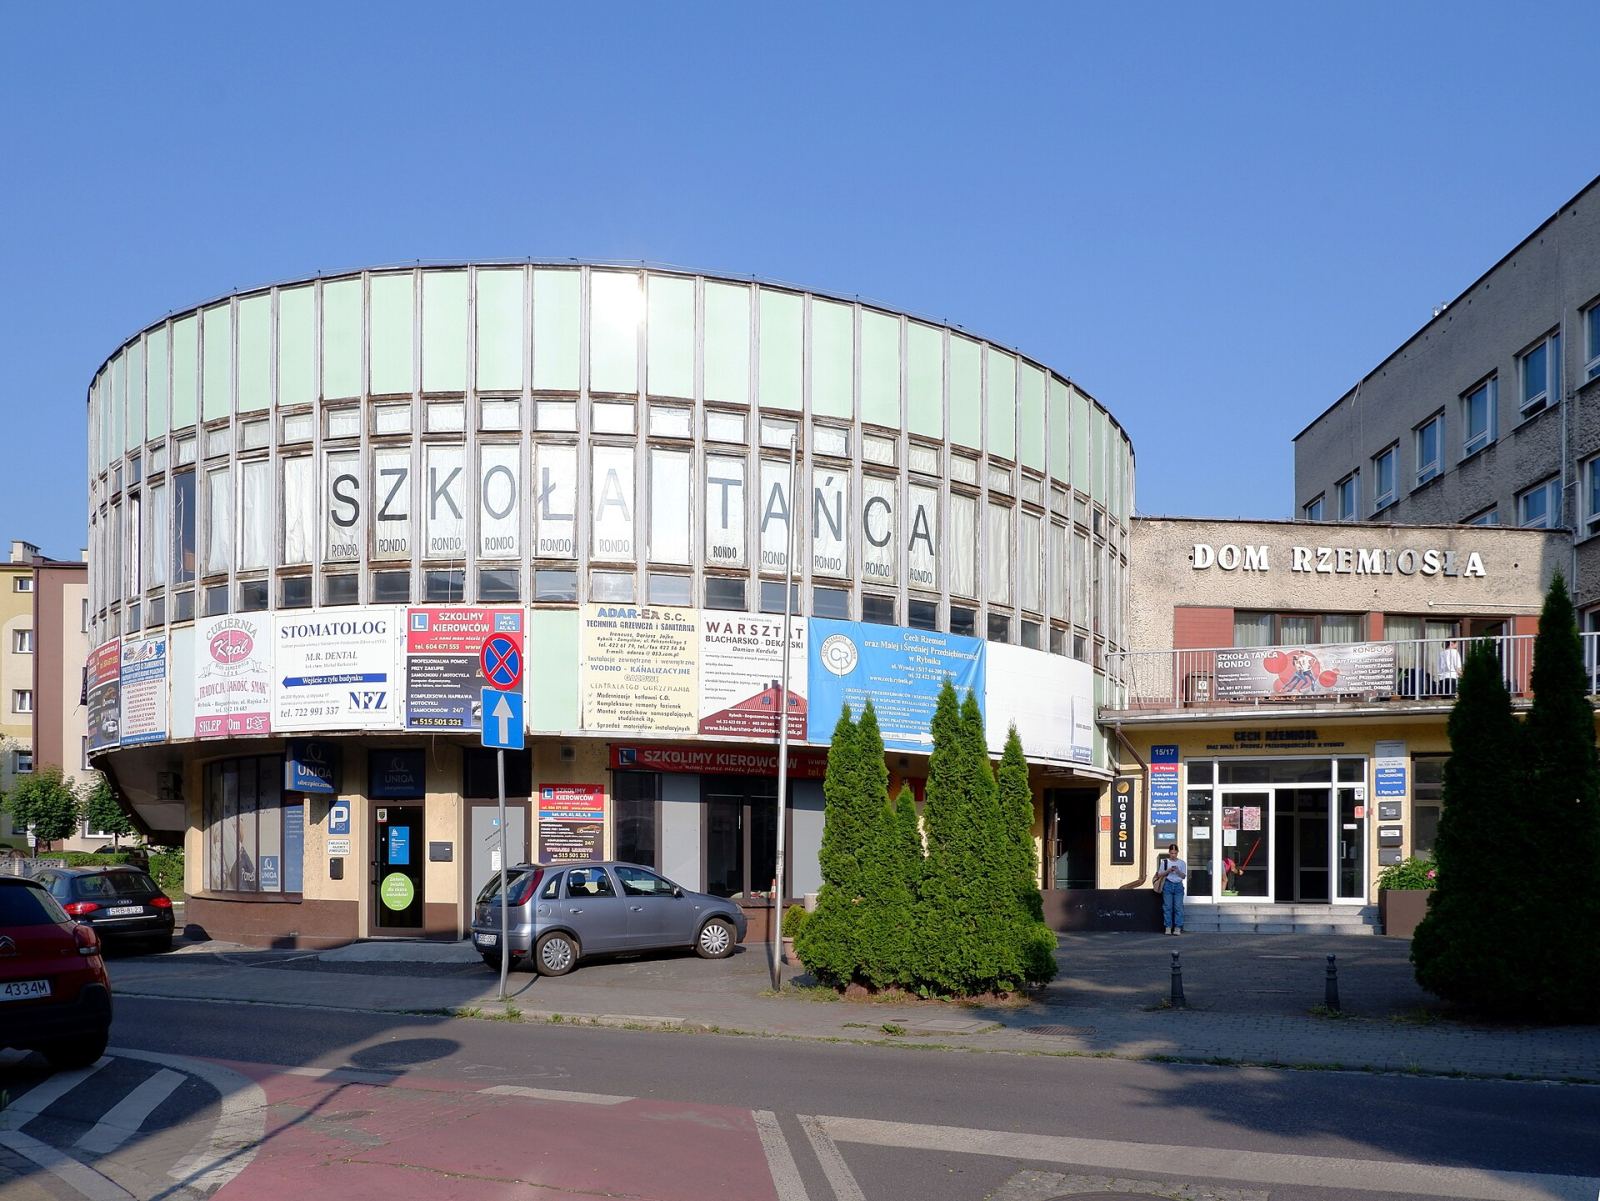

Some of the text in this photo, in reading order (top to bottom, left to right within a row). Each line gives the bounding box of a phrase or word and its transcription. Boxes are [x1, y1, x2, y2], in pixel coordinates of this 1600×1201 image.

[331, 465, 935, 556] SZKOŁA TAŃCA
[378, 538, 407, 552] RONDO
[431, 537, 461, 551] RONDO
[485, 535, 514, 551] RONDO
[540, 538, 571, 553] RONDO
[599, 538, 630, 553] RONDO
[331, 543, 359, 558] RONDO
[713, 545, 737, 559] RONDO
[814, 554, 842, 571] RONDO
[1192, 543, 1487, 577] DOM RZEMIOSŁA
[865, 561, 890, 578] RONDO
[909, 567, 933, 584] RONDO
[414, 616, 425, 629] L
[438, 612, 484, 621] SZKOLIMY
[663, 613, 686, 622] S.C.
[206, 618, 258, 641] CUKIERNIA
[281, 620, 387, 639] STOMATOLOG
[432, 622, 490, 632] KIEROWCÓW
[586, 619, 695, 632] TECHNIKA GRZEWCZA SANITARNA
[705, 635, 804, 649] BLACHARSKO DEKASKI
[903, 633, 920, 642] Cech
[213, 638, 250, 657] Król
[864, 640, 880, 648] oraz
[880, 640, 899, 651] Małej
[903, 642, 929, 655] Średniej
[305, 651, 358, 661] M.R. DENTAL
[916, 655, 941, 667] Rybniku
[1217, 651, 1278, 661] SZKOŁA TAŃCA
[590, 664, 691, 675] WODNO KANALIZACYJNE
[303, 676, 322, 685] Wejście
[327, 676, 339, 684] tyłu
[339, 675, 363, 683] budynku
[348, 691, 388, 710] NFZ
[280, 709, 293, 717] tel.
[295, 708, 308, 717] 722
[310, 708, 323, 716] 991
[326, 706, 339, 715] 337
[199, 719, 222, 733] SKLEP
[1234, 731, 1260, 741] CECH
[1154, 748, 1175, 756] 15/17
[643, 750, 798, 769] SZKOLIMY KIEROWCW
[298, 764, 332, 778] UNIQA
[385, 774, 414, 783] UNIQA
[330, 806, 348, 829] P
[4, 981, 47, 997] 4334M
